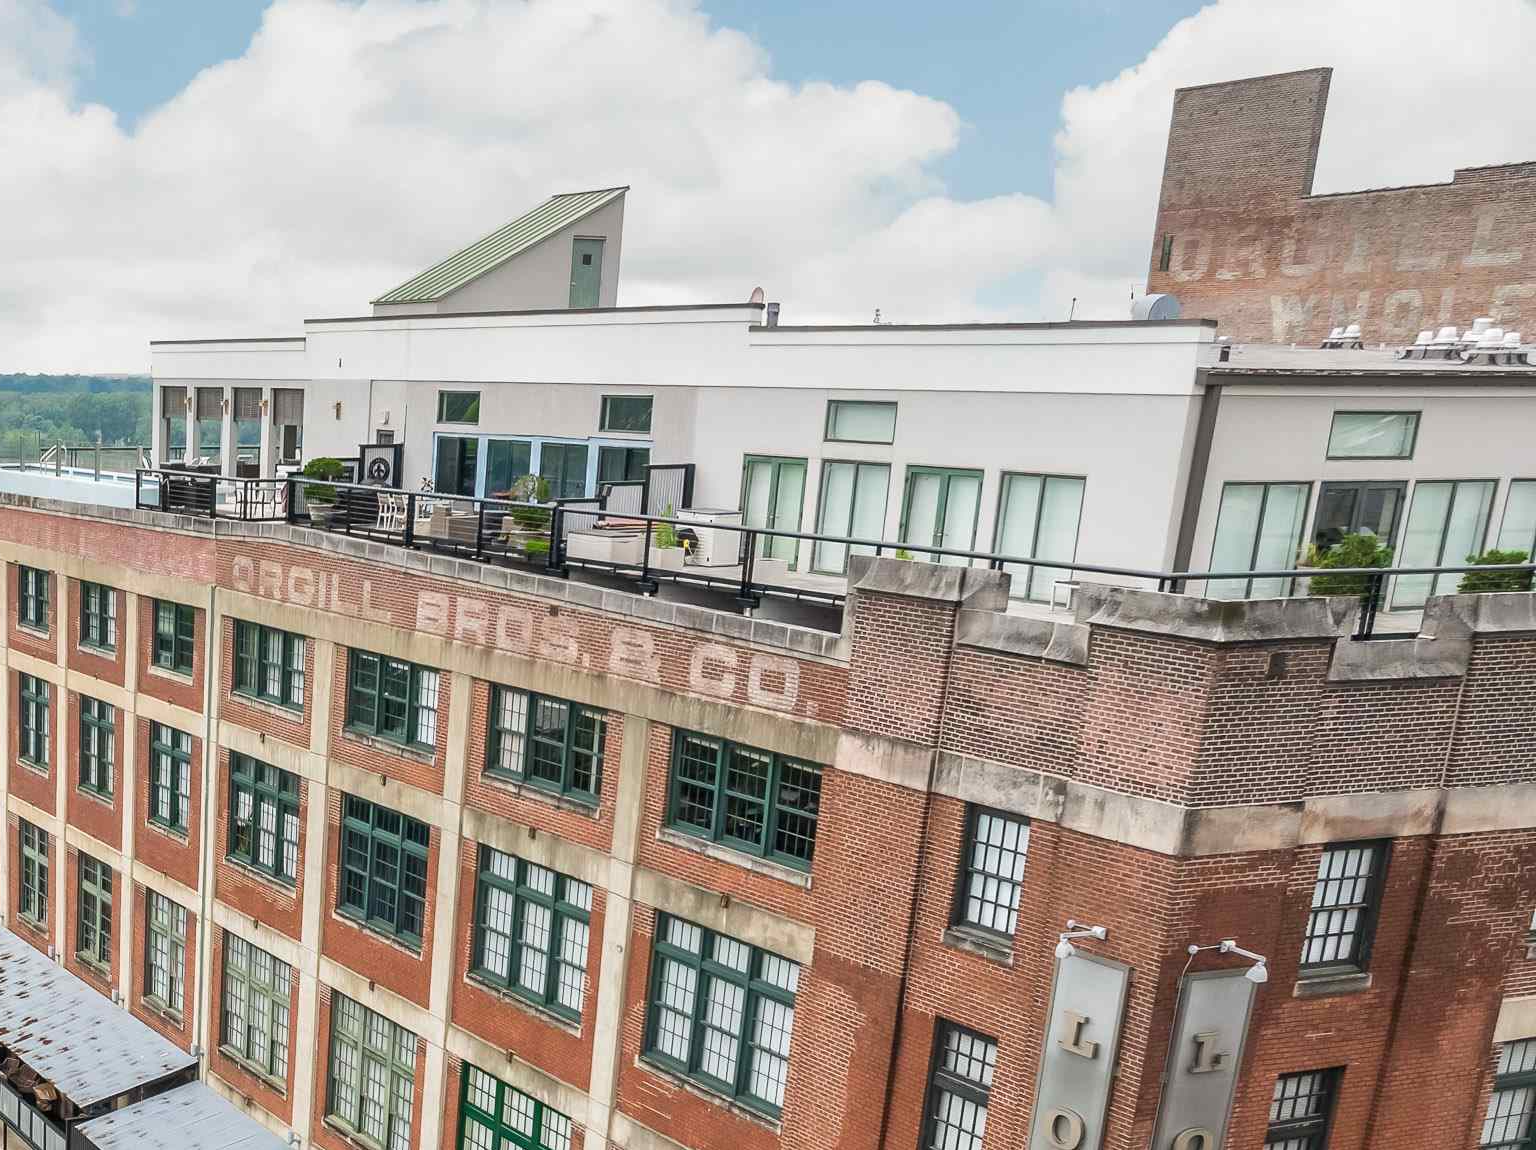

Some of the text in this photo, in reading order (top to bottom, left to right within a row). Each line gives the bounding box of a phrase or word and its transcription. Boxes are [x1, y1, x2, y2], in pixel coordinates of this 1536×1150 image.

[232, 554, 819, 717] ORGILL BROS. & CO.
